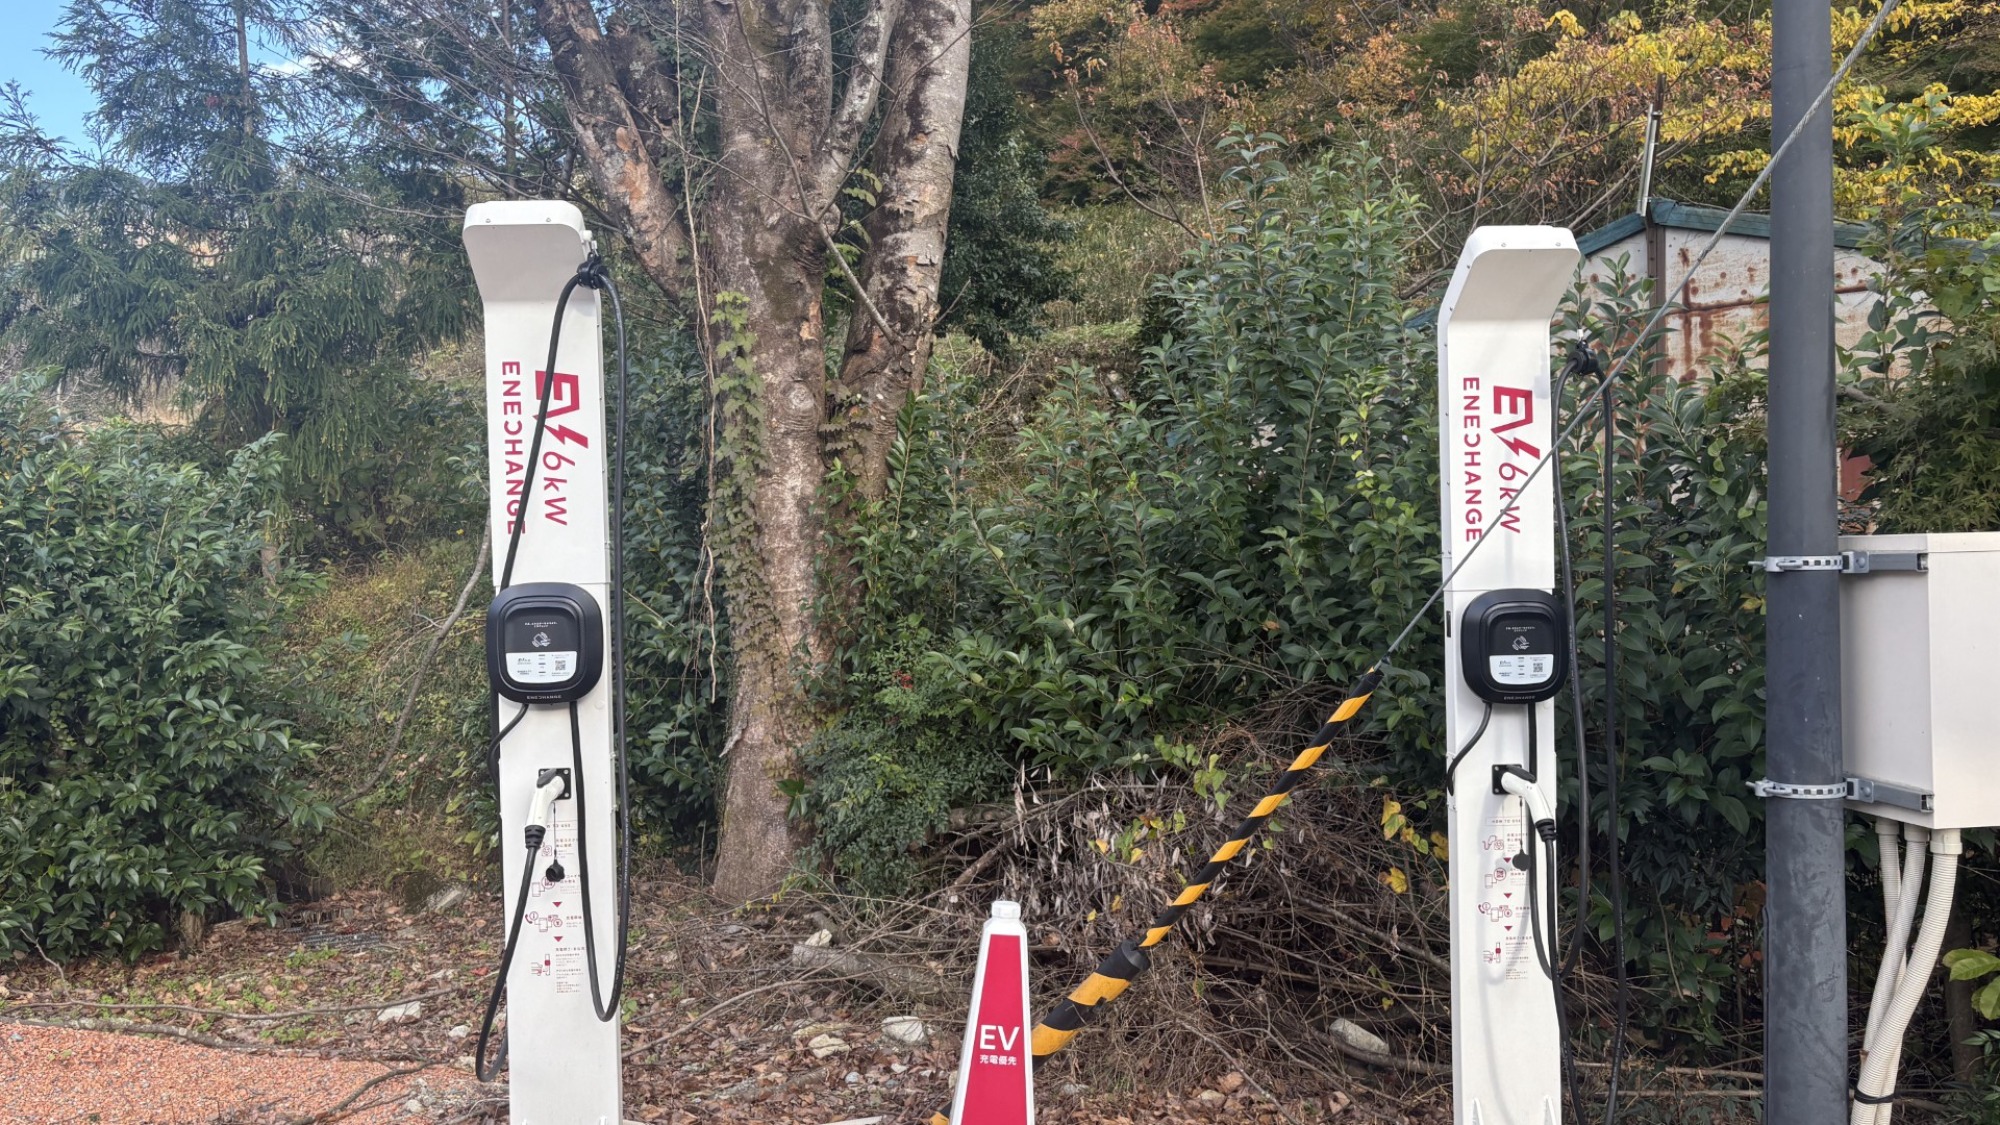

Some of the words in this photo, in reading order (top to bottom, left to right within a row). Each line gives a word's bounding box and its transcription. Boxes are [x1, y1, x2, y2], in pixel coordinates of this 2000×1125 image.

[502, 361, 526, 535] ENECHANGE
[1463, 377, 1483, 542] ENECHANGE
[1490, 385, 1541, 460] EV
[542, 451, 576, 526] 6kW
[1498, 462, 1529, 534] 6kW
[979, 1025, 1020, 1051] EV
[979, 1055, 1016, 1065] 充電優先
